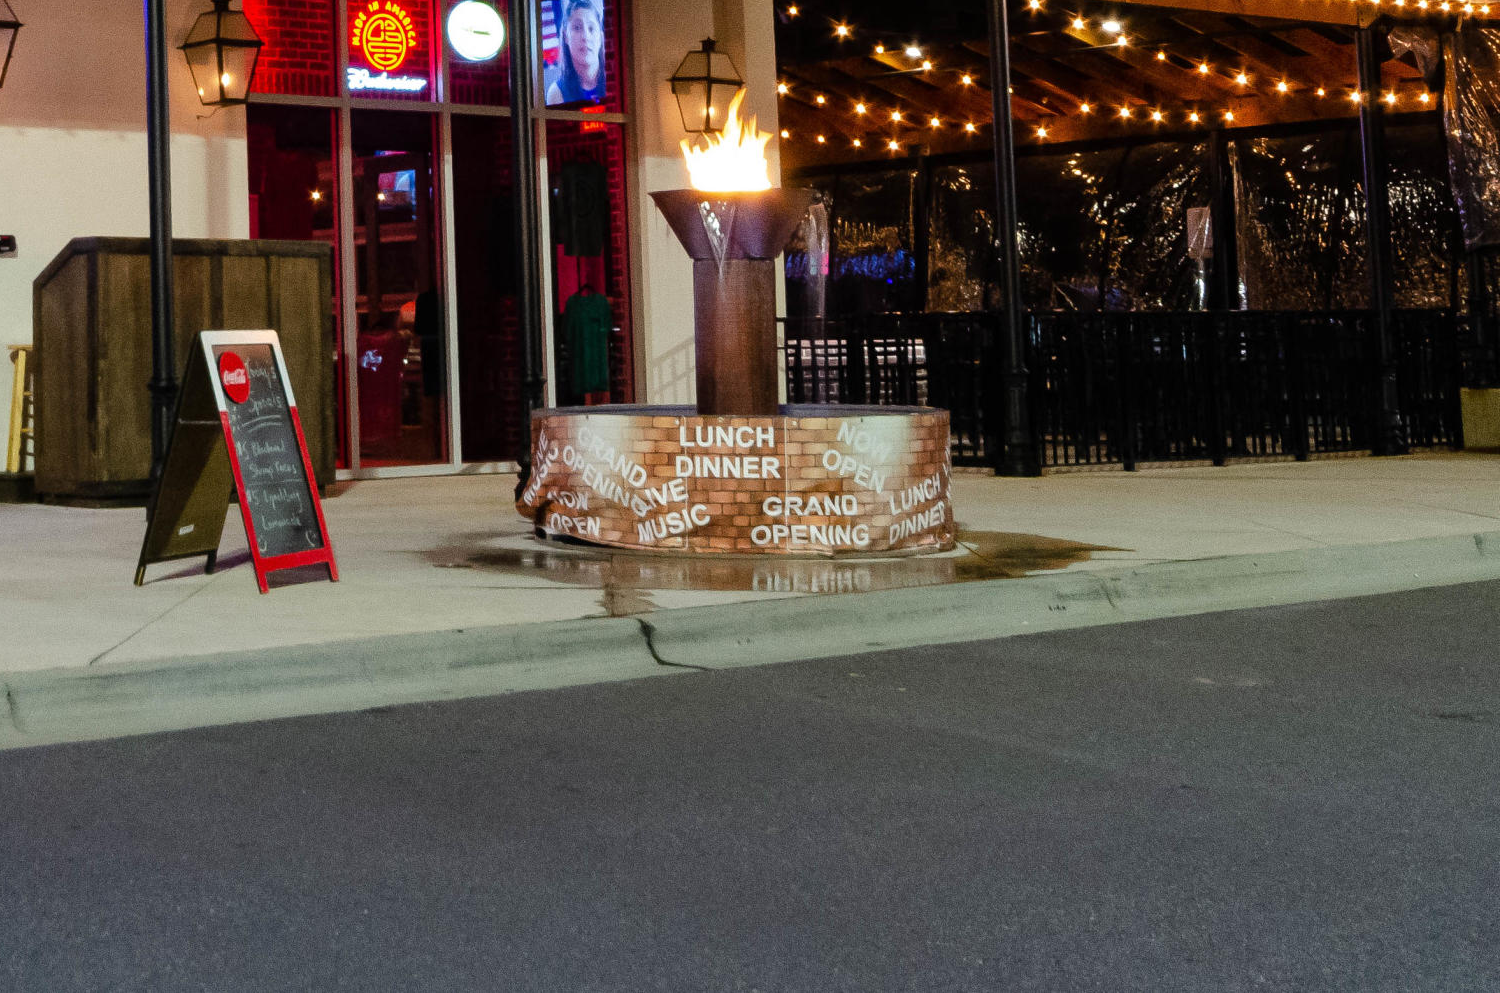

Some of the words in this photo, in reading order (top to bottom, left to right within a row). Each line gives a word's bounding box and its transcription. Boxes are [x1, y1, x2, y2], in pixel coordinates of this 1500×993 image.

[352, 11, 367, 46] MADE
[368, 0, 380, 13] IN
[385, 0, 417, 47] AMERICA
[680, 425, 775, 448] LUNCH
[578, 427, 647, 488] GRAND
[675, 455, 781, 479] DINNER
[822, 449, 886, 495] OPEN
[562, 445, 648, 518] OPENING
[644, 478, 689, 507] LIVE
[889, 472, 941, 516] LUNCH
[550, 512, 601, 537] OPEN
[637, 503, 711, 543] MUSIC
[762, 495, 858, 517] GRAND
[889, 500, 946, 545] DINNER
[751, 523, 870, 546] OPENING
